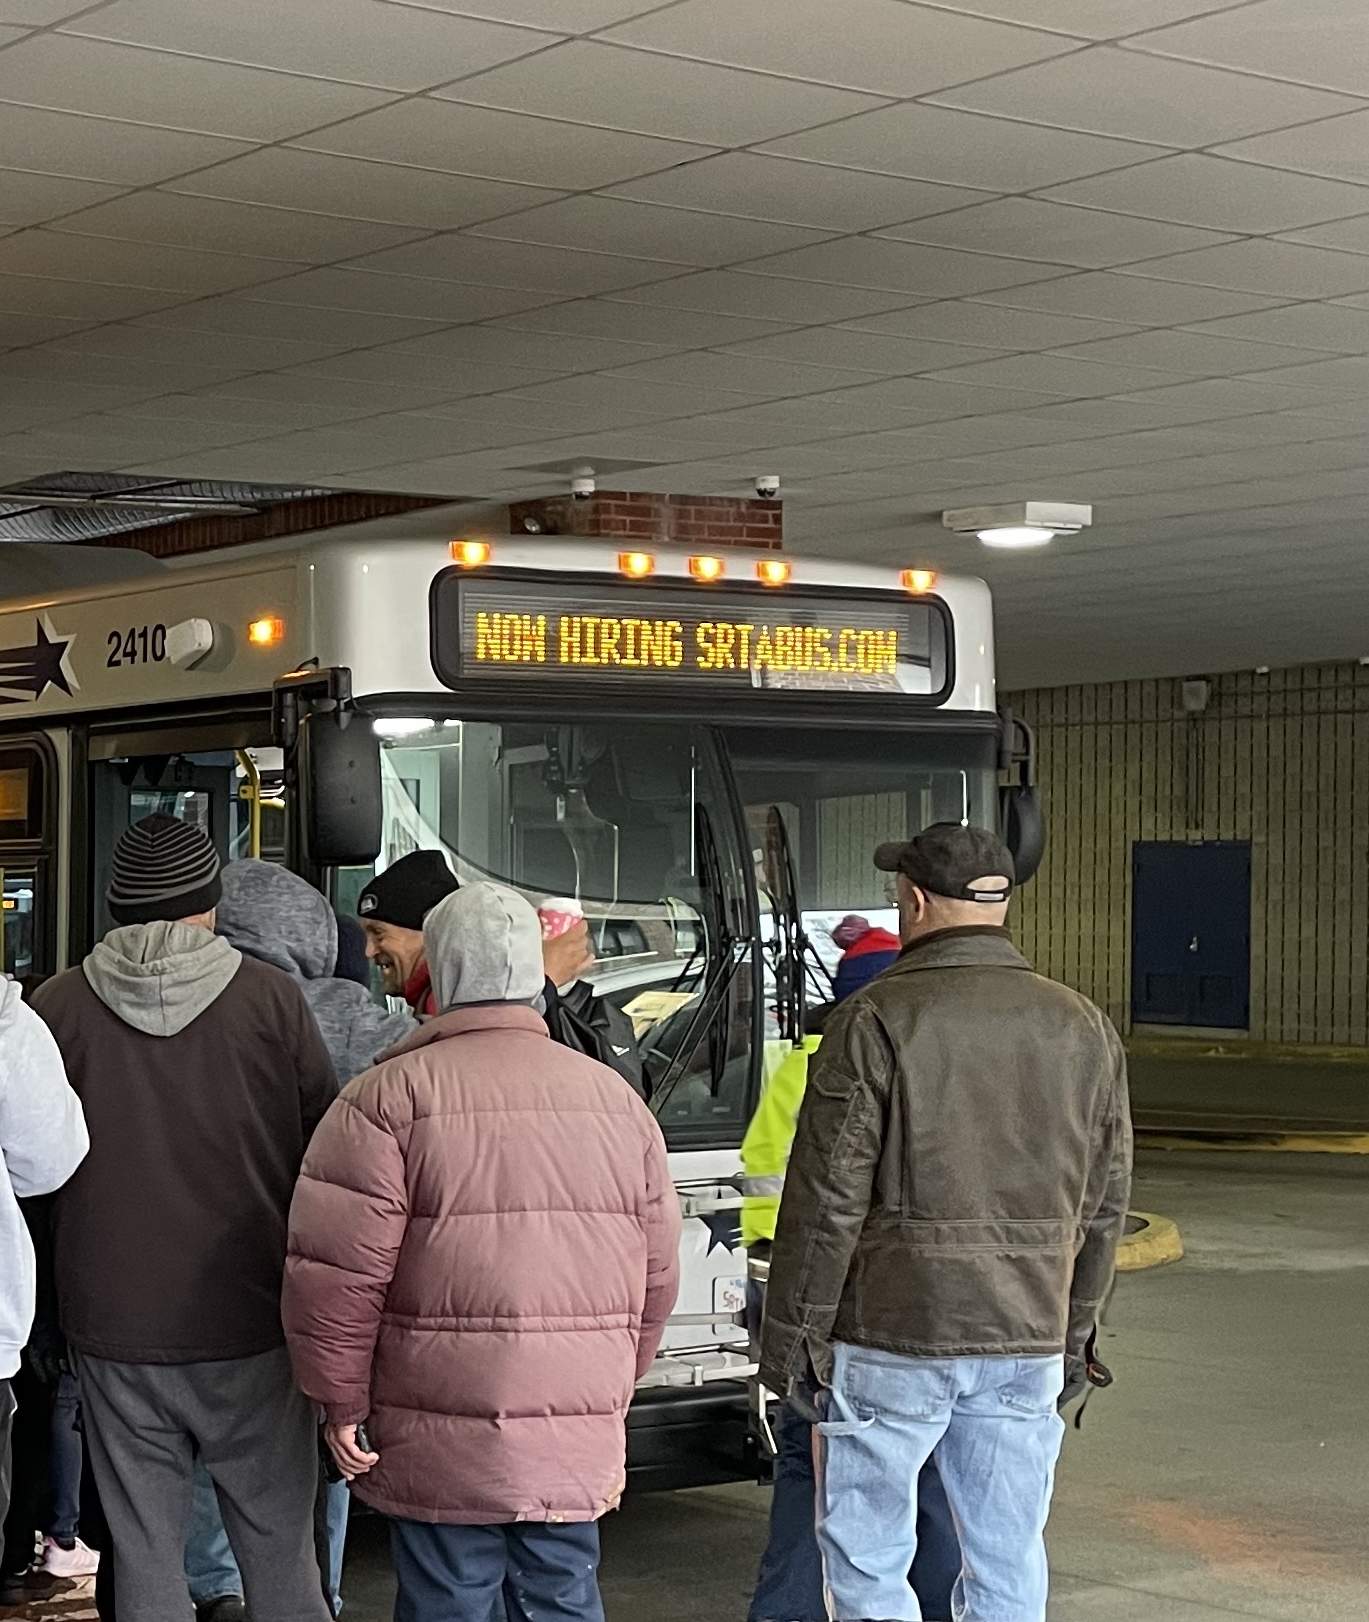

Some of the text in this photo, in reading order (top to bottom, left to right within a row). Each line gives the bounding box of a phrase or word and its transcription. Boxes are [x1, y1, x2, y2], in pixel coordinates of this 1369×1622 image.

[107, 623, 167, 668] 2410
[477, 612, 898, 675] NOW HIRING SRTABUS.COM
